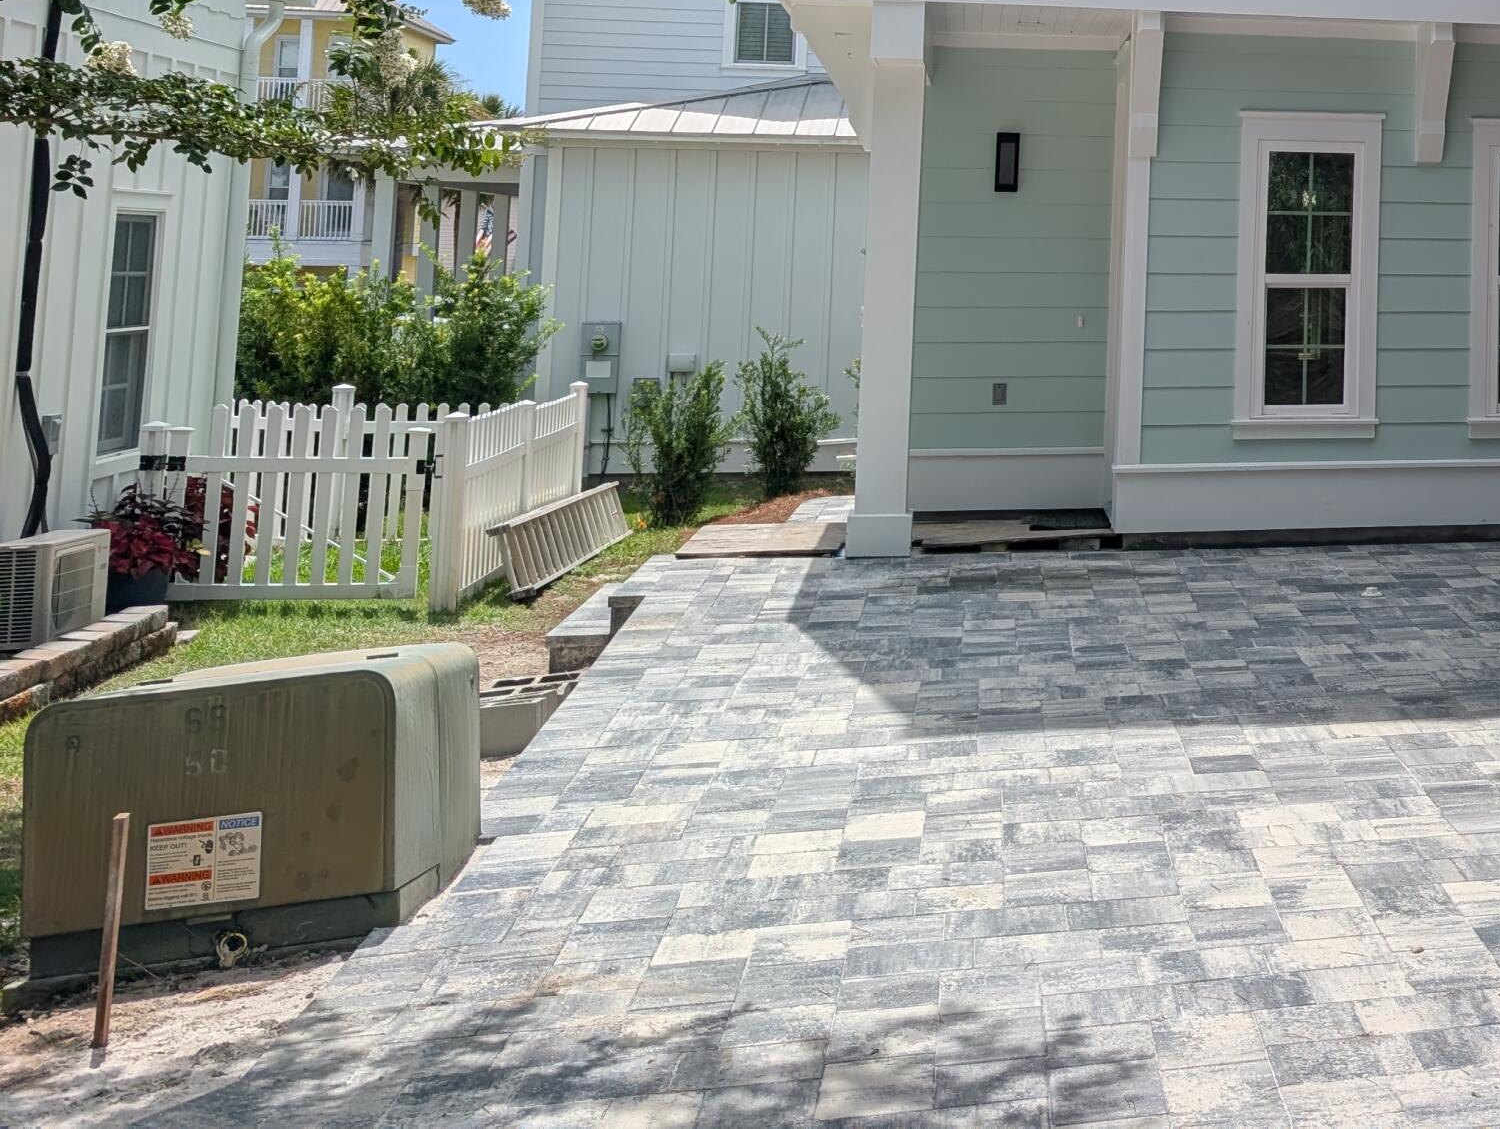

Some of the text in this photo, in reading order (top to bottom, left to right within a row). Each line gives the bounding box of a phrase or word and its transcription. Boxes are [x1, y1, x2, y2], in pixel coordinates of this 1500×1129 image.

[164, 823, 211, 835] WARNING
[221, 818, 257, 828] NOTICE
[162, 871, 210, 883] WARNING
